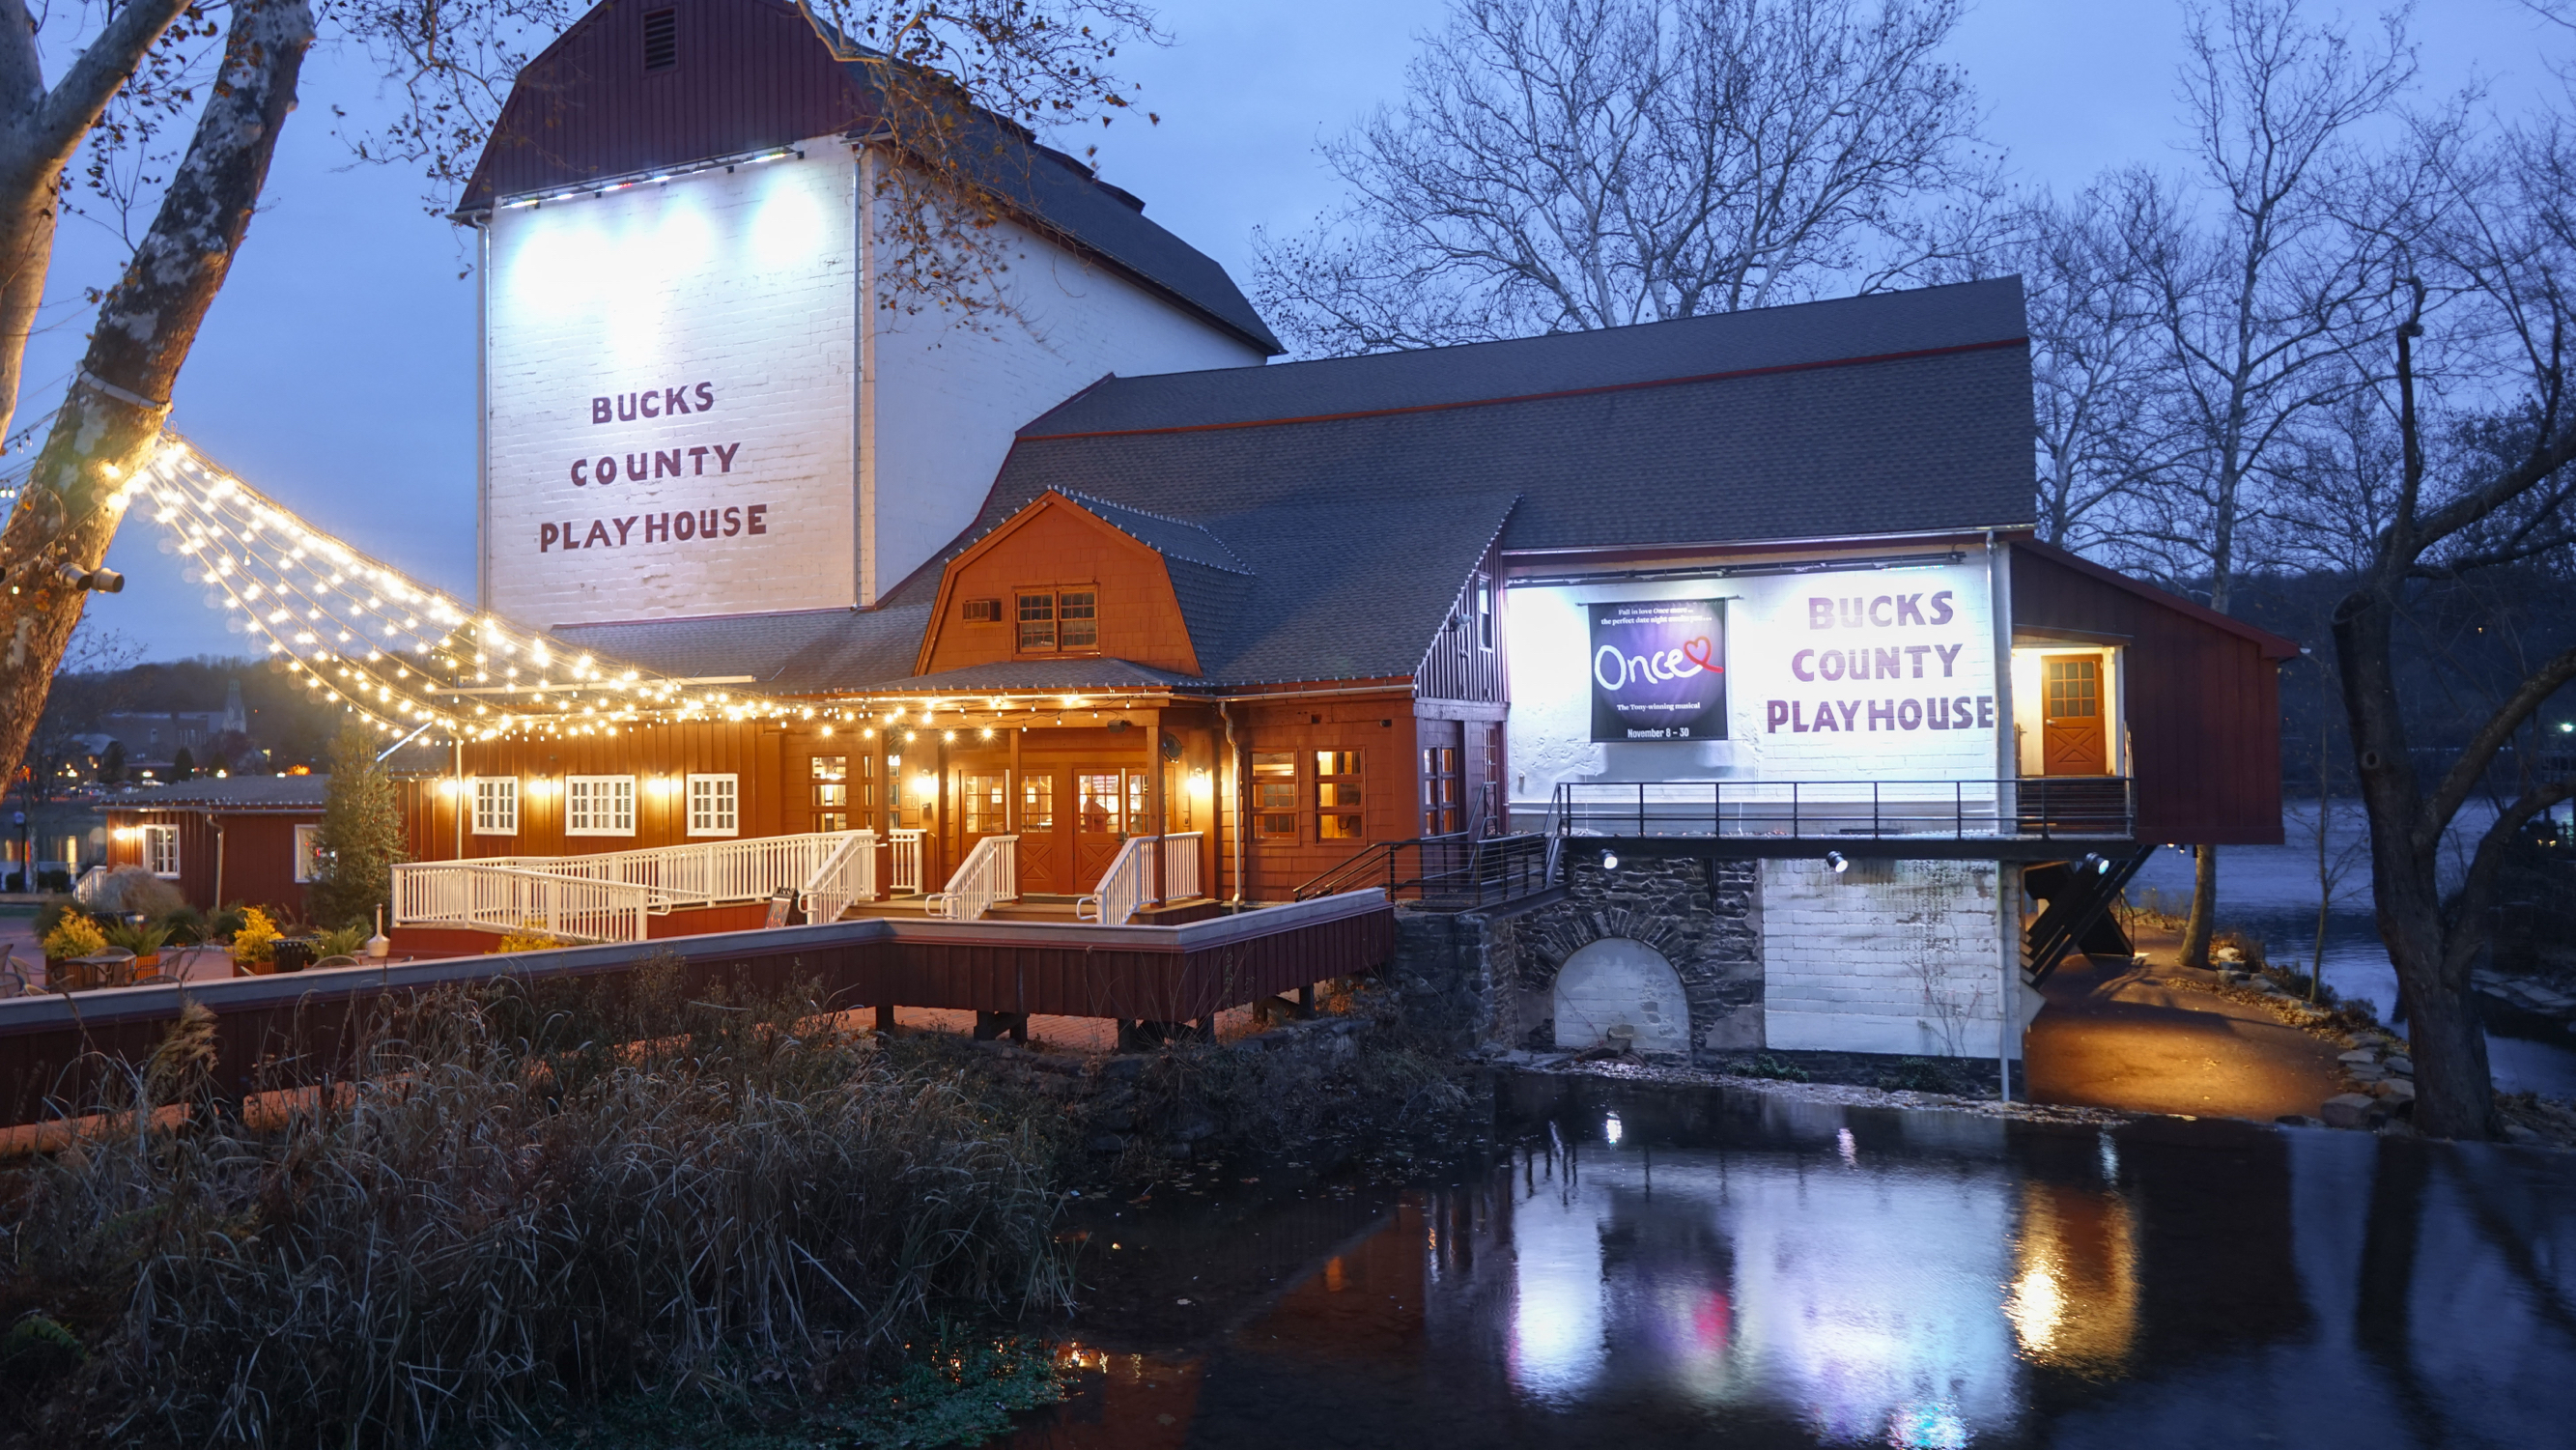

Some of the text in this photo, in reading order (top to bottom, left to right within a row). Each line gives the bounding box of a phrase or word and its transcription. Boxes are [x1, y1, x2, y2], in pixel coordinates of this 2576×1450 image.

[592, 382, 714, 424] BUCKS
[570, 441, 741, 487] COUNTY
[540, 503, 768, 554] PLAYHOUSE
[1612, 617, 1635, 626] perfect
[1808, 590, 1954, 630] BUCKS
[1594, 644, 1703, 691] Once
[1791, 643, 1964, 682] COUNTY
[1629, 703, 1674, 712] Tony-winning
[1767, 696, 1995, 734] PLAYHOUSE
[1628, 727, 1664, 738] November
[1665, 727, 1671, 737] 8
[1679, 727, 1689, 737] 30
